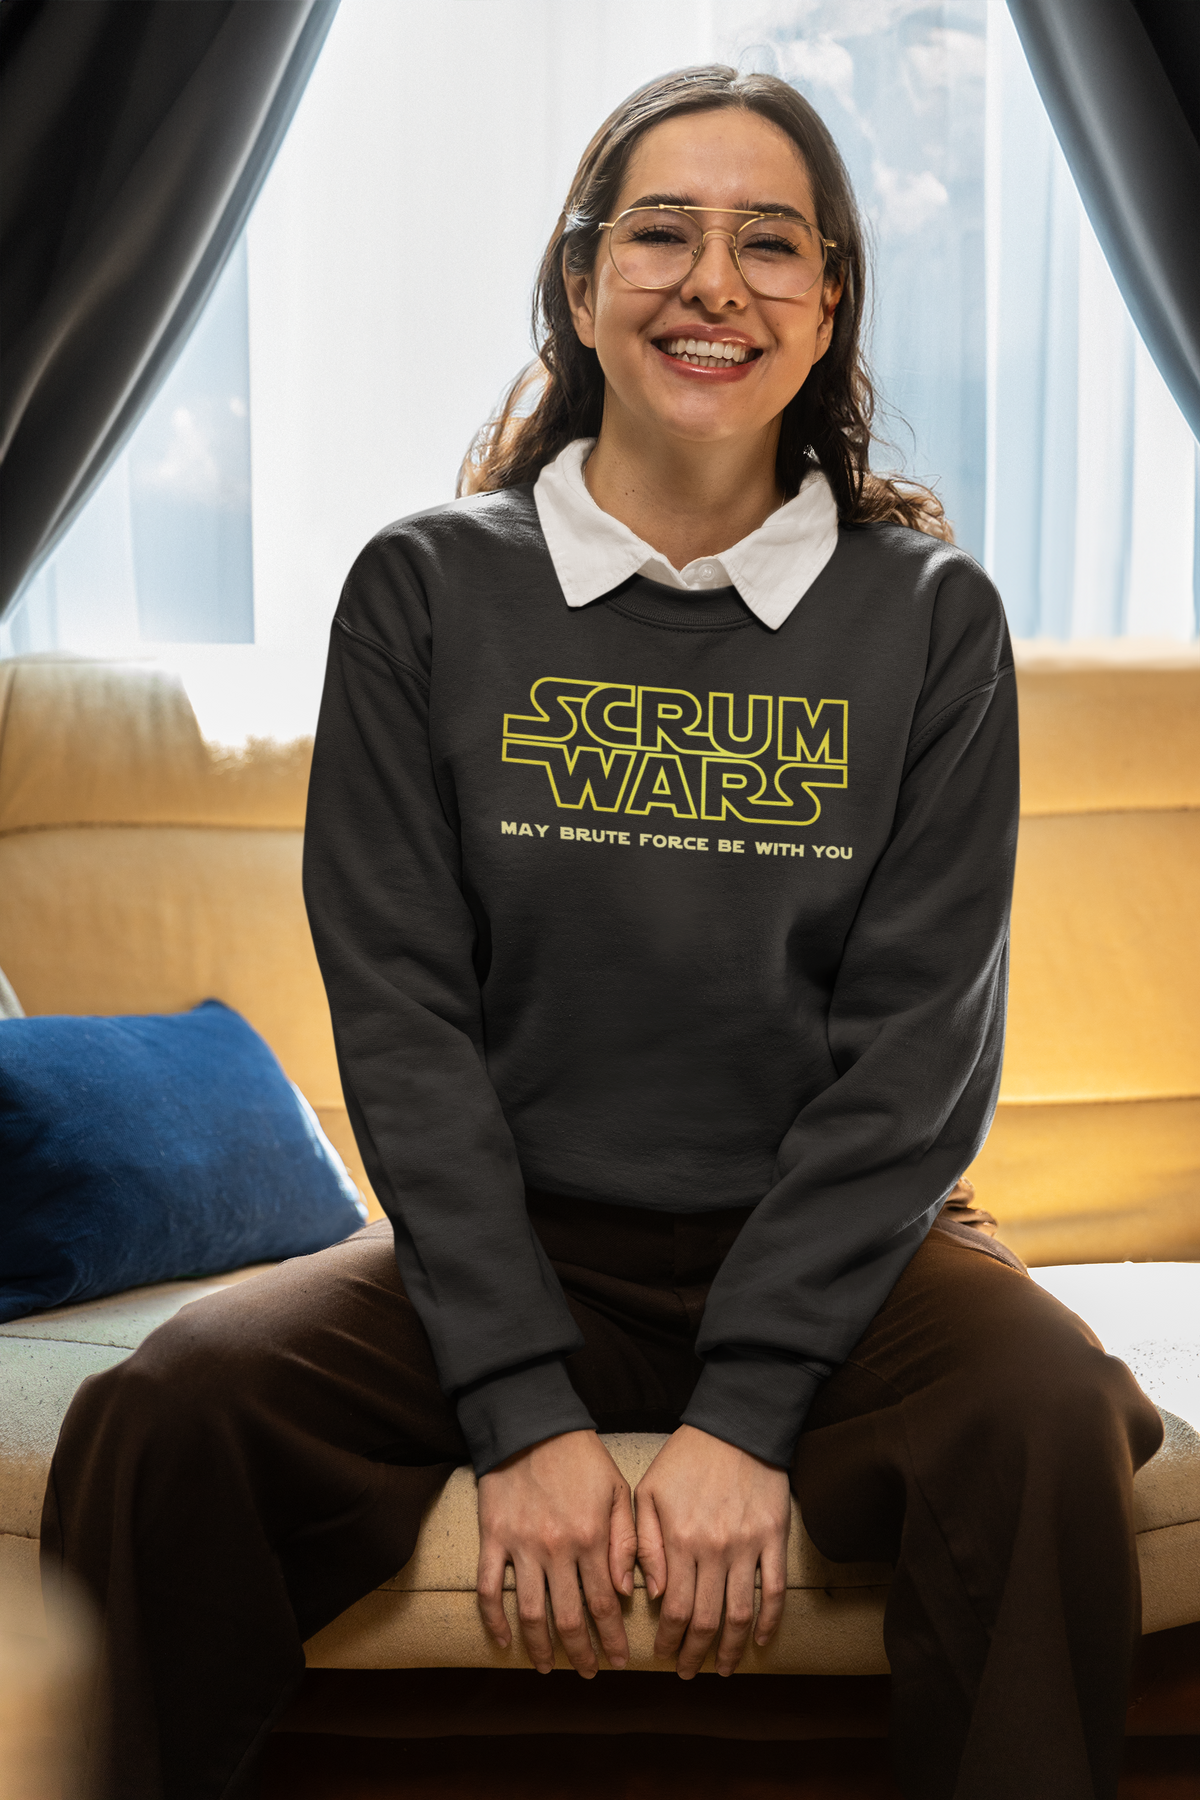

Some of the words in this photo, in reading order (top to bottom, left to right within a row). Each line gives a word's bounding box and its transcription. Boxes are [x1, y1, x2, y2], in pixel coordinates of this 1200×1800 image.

[503, 676, 848, 764] SCRUM
[501, 738, 848, 826] WARS
[501, 821, 550, 838] MAY
[559, 826, 631, 846] BRUTE
[639, 833, 709, 851] FORCE
[717, 839, 745, 854] BE
[755, 841, 805, 858] WITH
[811, 845, 853, 860] YOU
